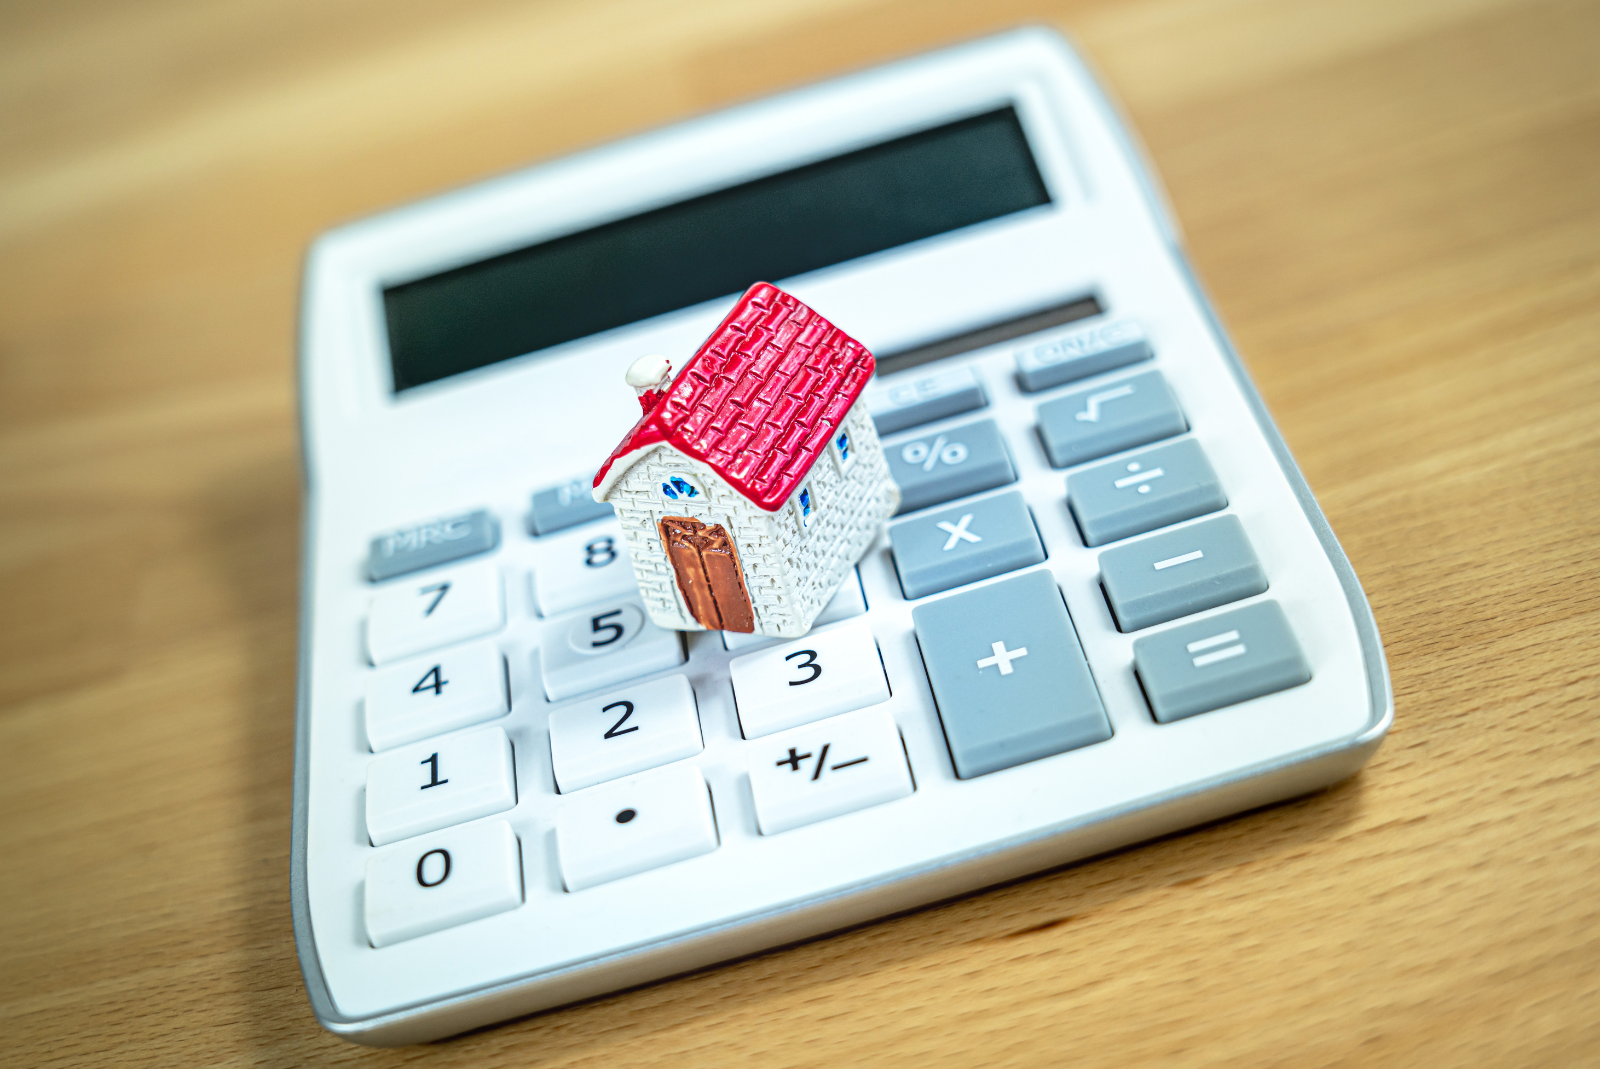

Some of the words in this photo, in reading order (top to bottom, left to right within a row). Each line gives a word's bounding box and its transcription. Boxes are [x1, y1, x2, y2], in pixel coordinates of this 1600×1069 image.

[901, 435, 969, 472] %
[585, 536, 617, 568] 8
[418, 583, 452, 616] 7
[591, 610, 625, 648] 5
[412, 665, 450, 696] 4
[784, 649, 823, 686] 3
[602, 700, 640, 740] 2
[420, 752, 449, 790] 1
[416, 848, 452, 887] 0
